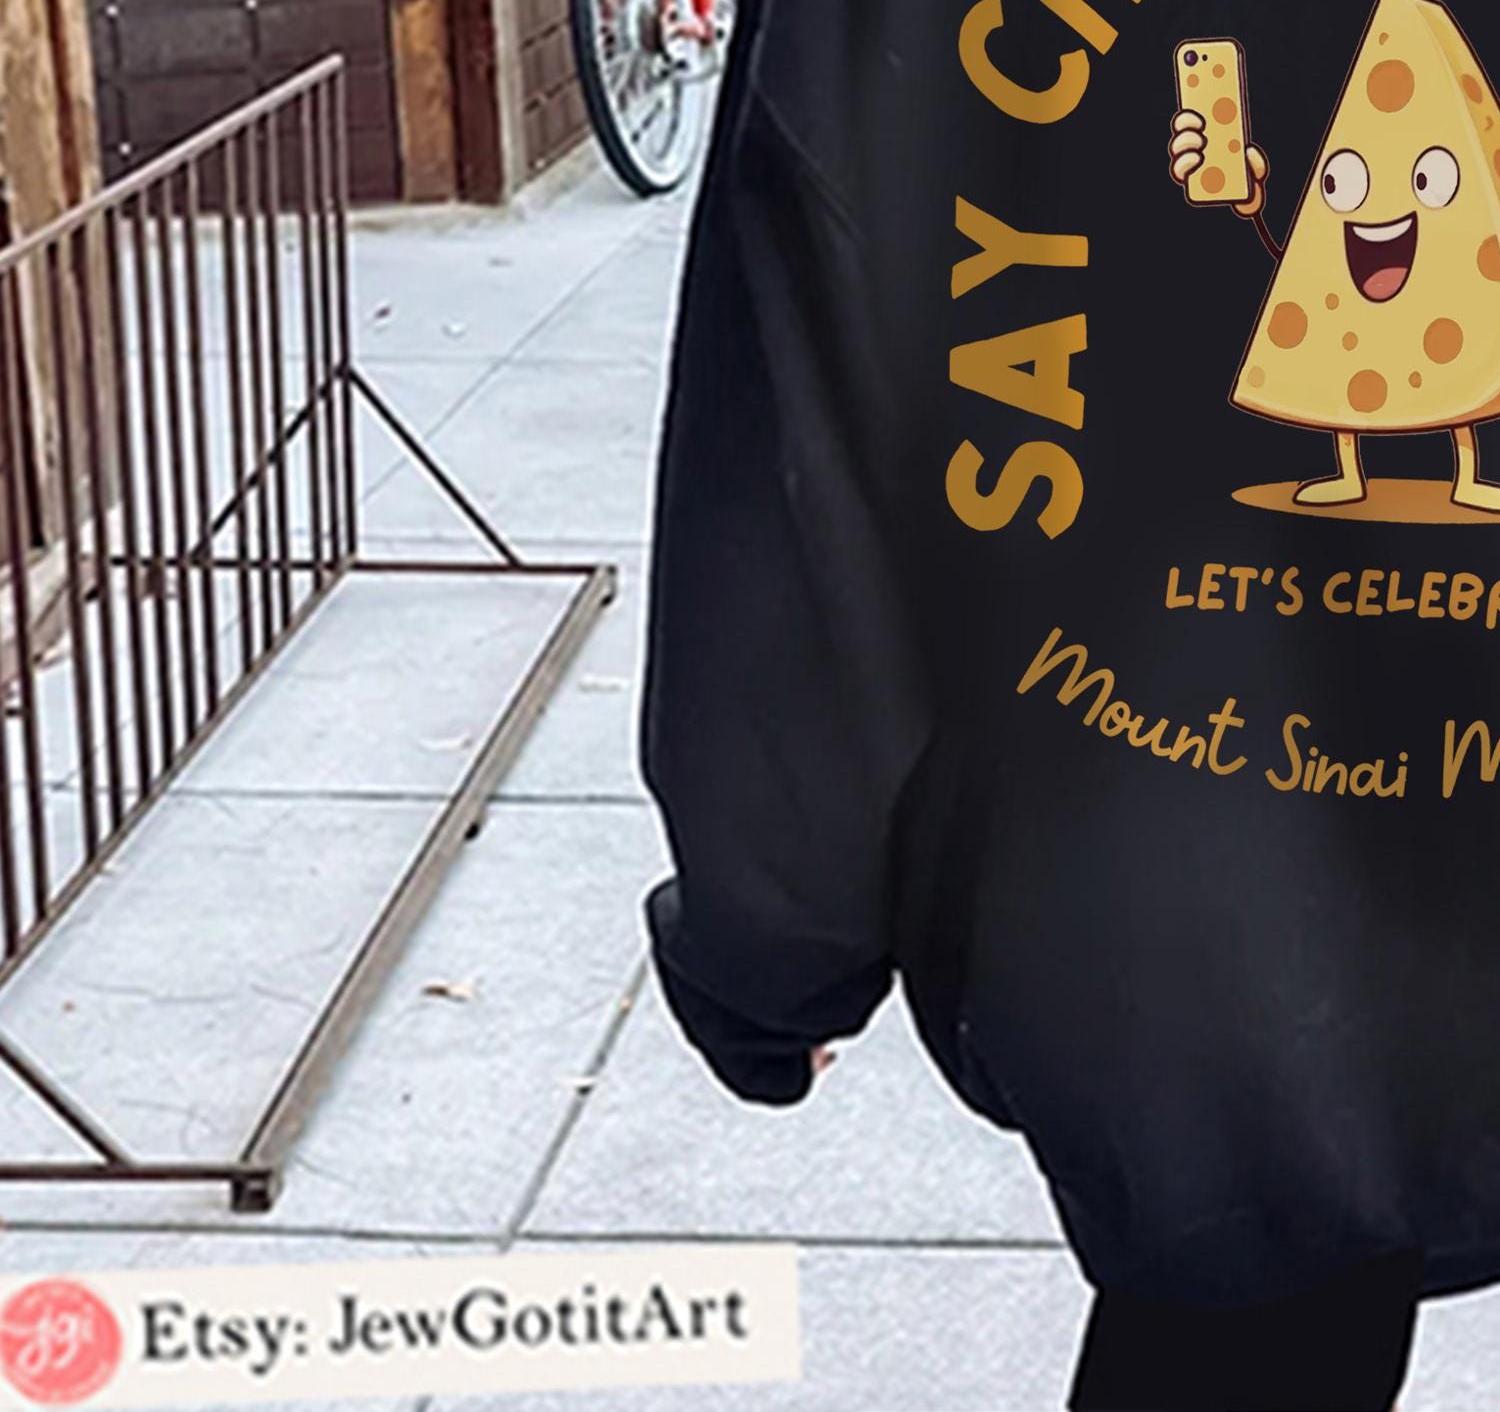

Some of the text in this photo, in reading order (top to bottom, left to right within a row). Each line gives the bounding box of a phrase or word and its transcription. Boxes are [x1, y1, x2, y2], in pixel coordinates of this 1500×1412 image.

[946, 195, 1088, 541] SAY
[1166, 563, 1304, 616] LET'S
[1017, 628, 1248, 776] Mount
[1265, 714, 1409, 798] Sinai
